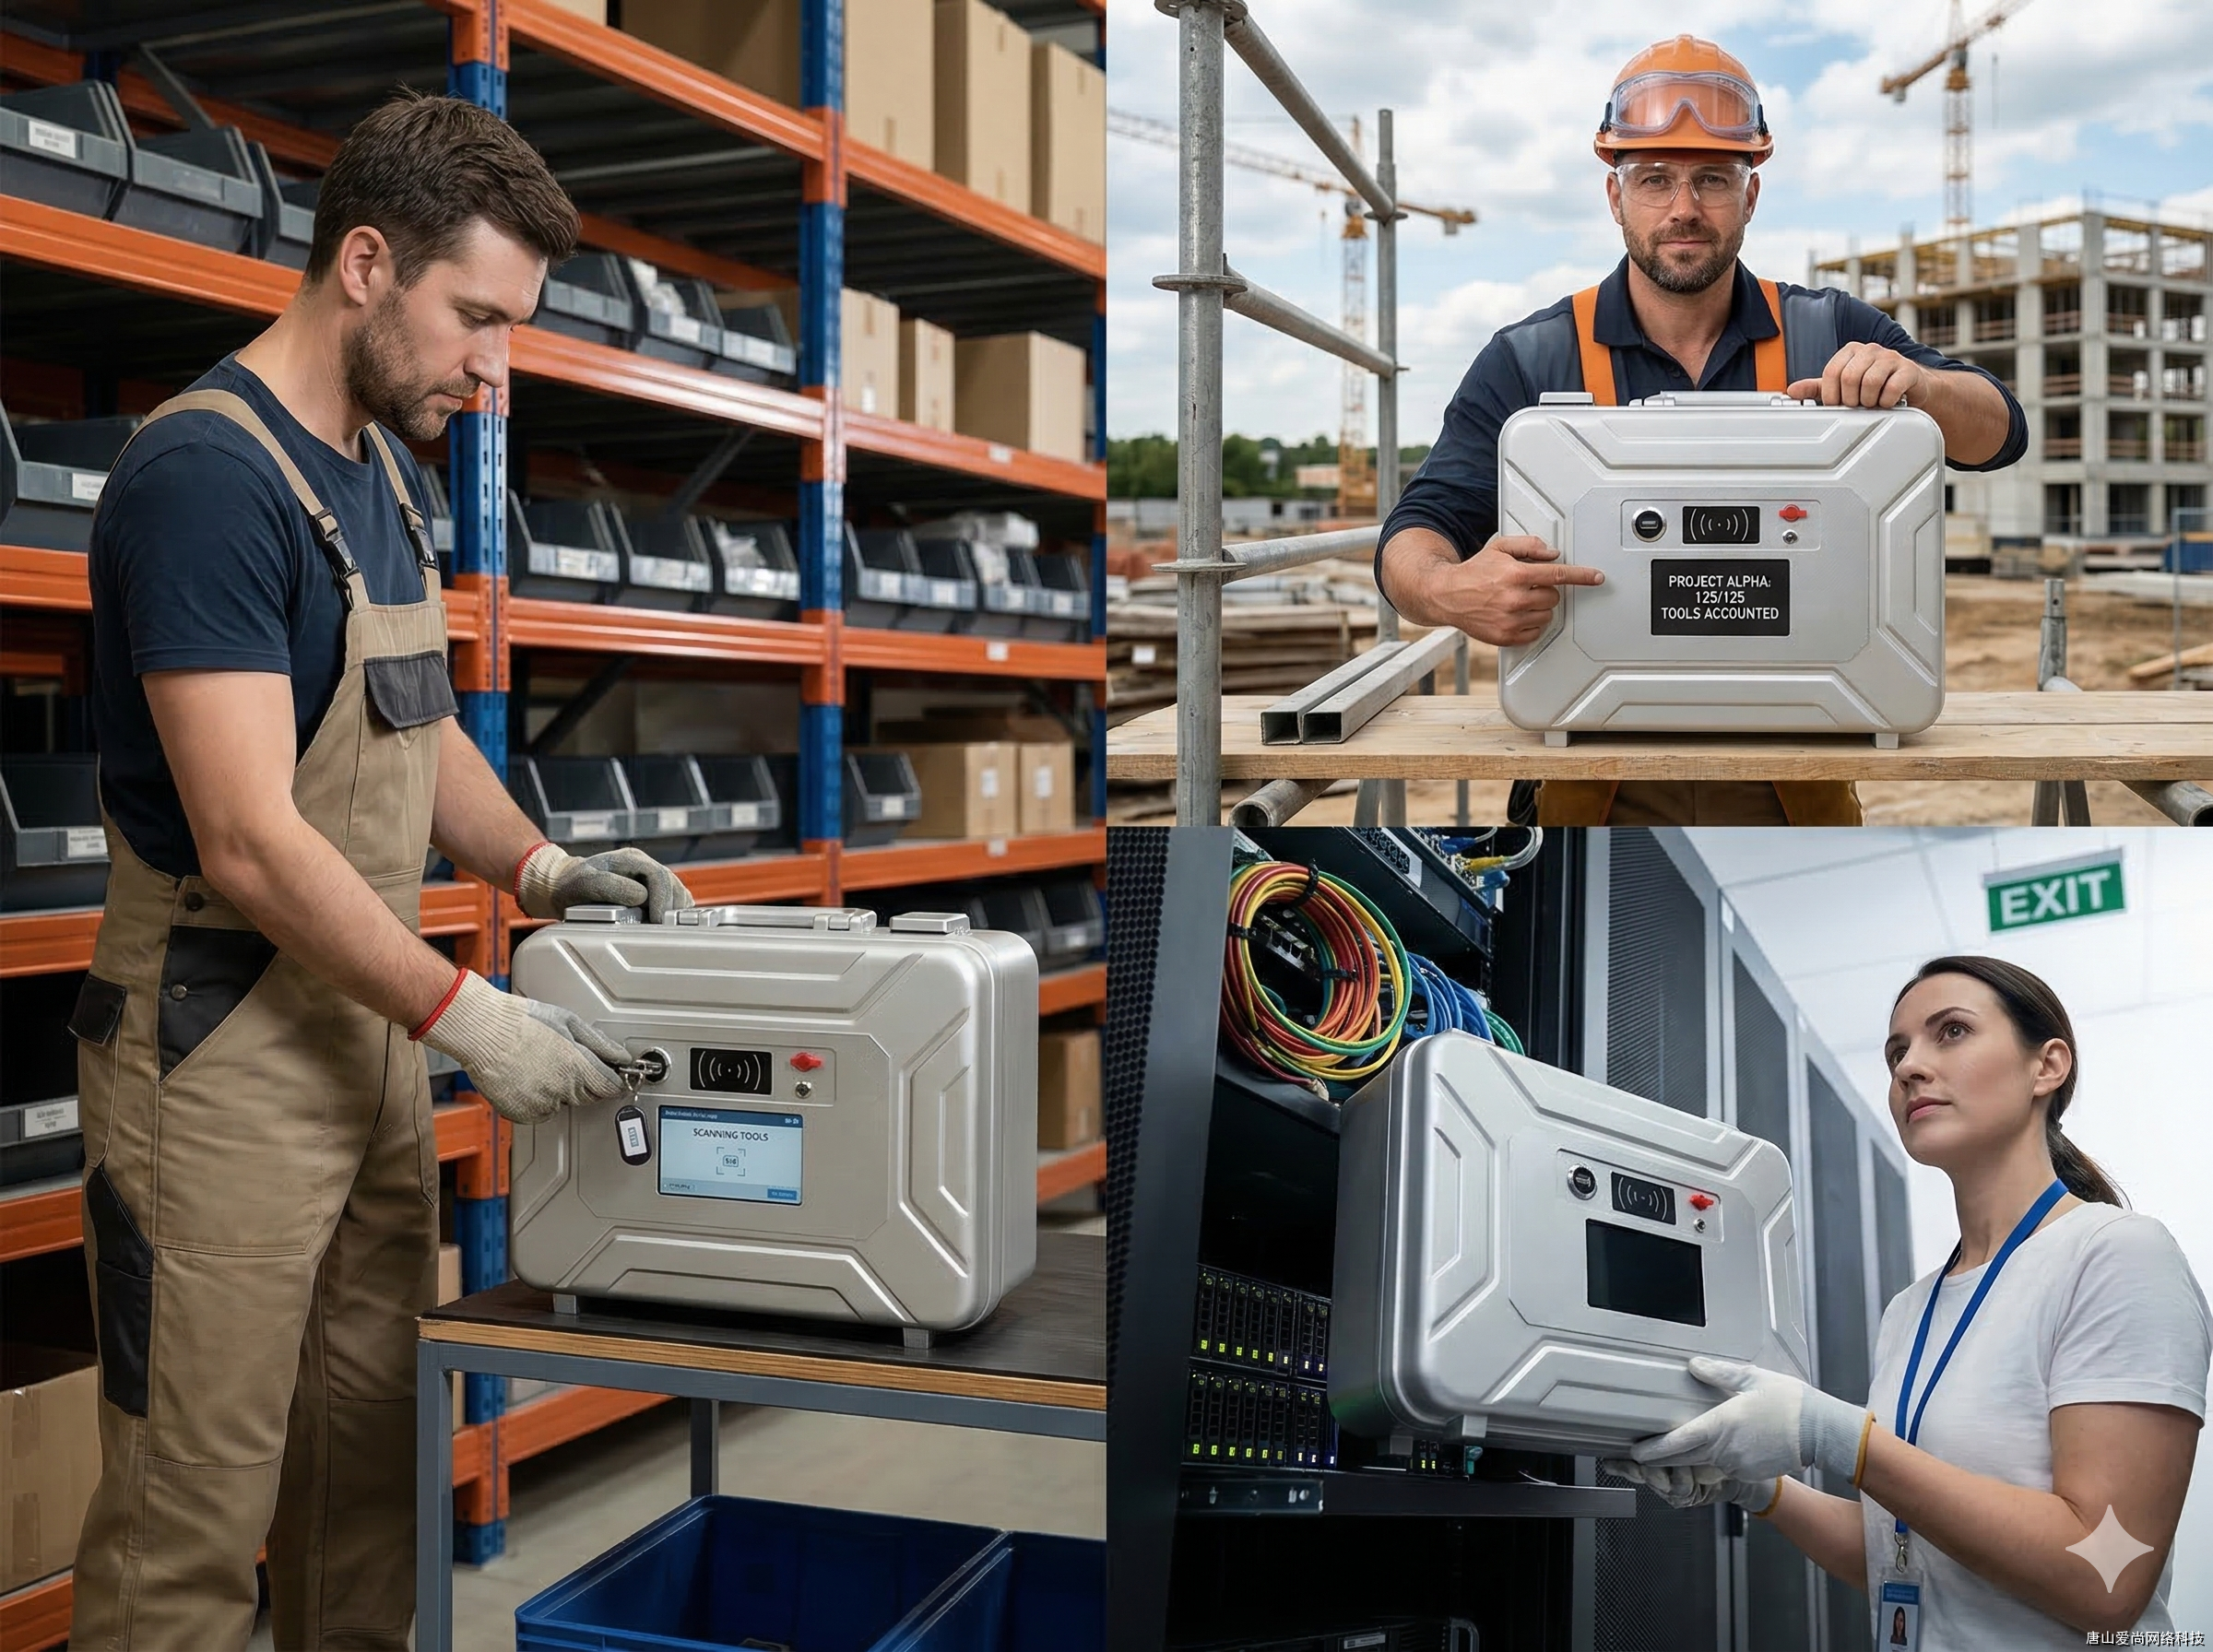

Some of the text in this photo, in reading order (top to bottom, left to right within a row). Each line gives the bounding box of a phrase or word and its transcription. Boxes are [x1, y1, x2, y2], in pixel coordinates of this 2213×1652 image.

[1668, 575, 1771, 587] PROJECT ALPHA:
[1695, 591, 1746, 604] 125/125
[1661, 608, 1780, 620] TOOLS ACCOUNTED
[1999, 869, 2111, 926] EXIT
[692, 1127, 769, 1142] SCANNING TOOLS
